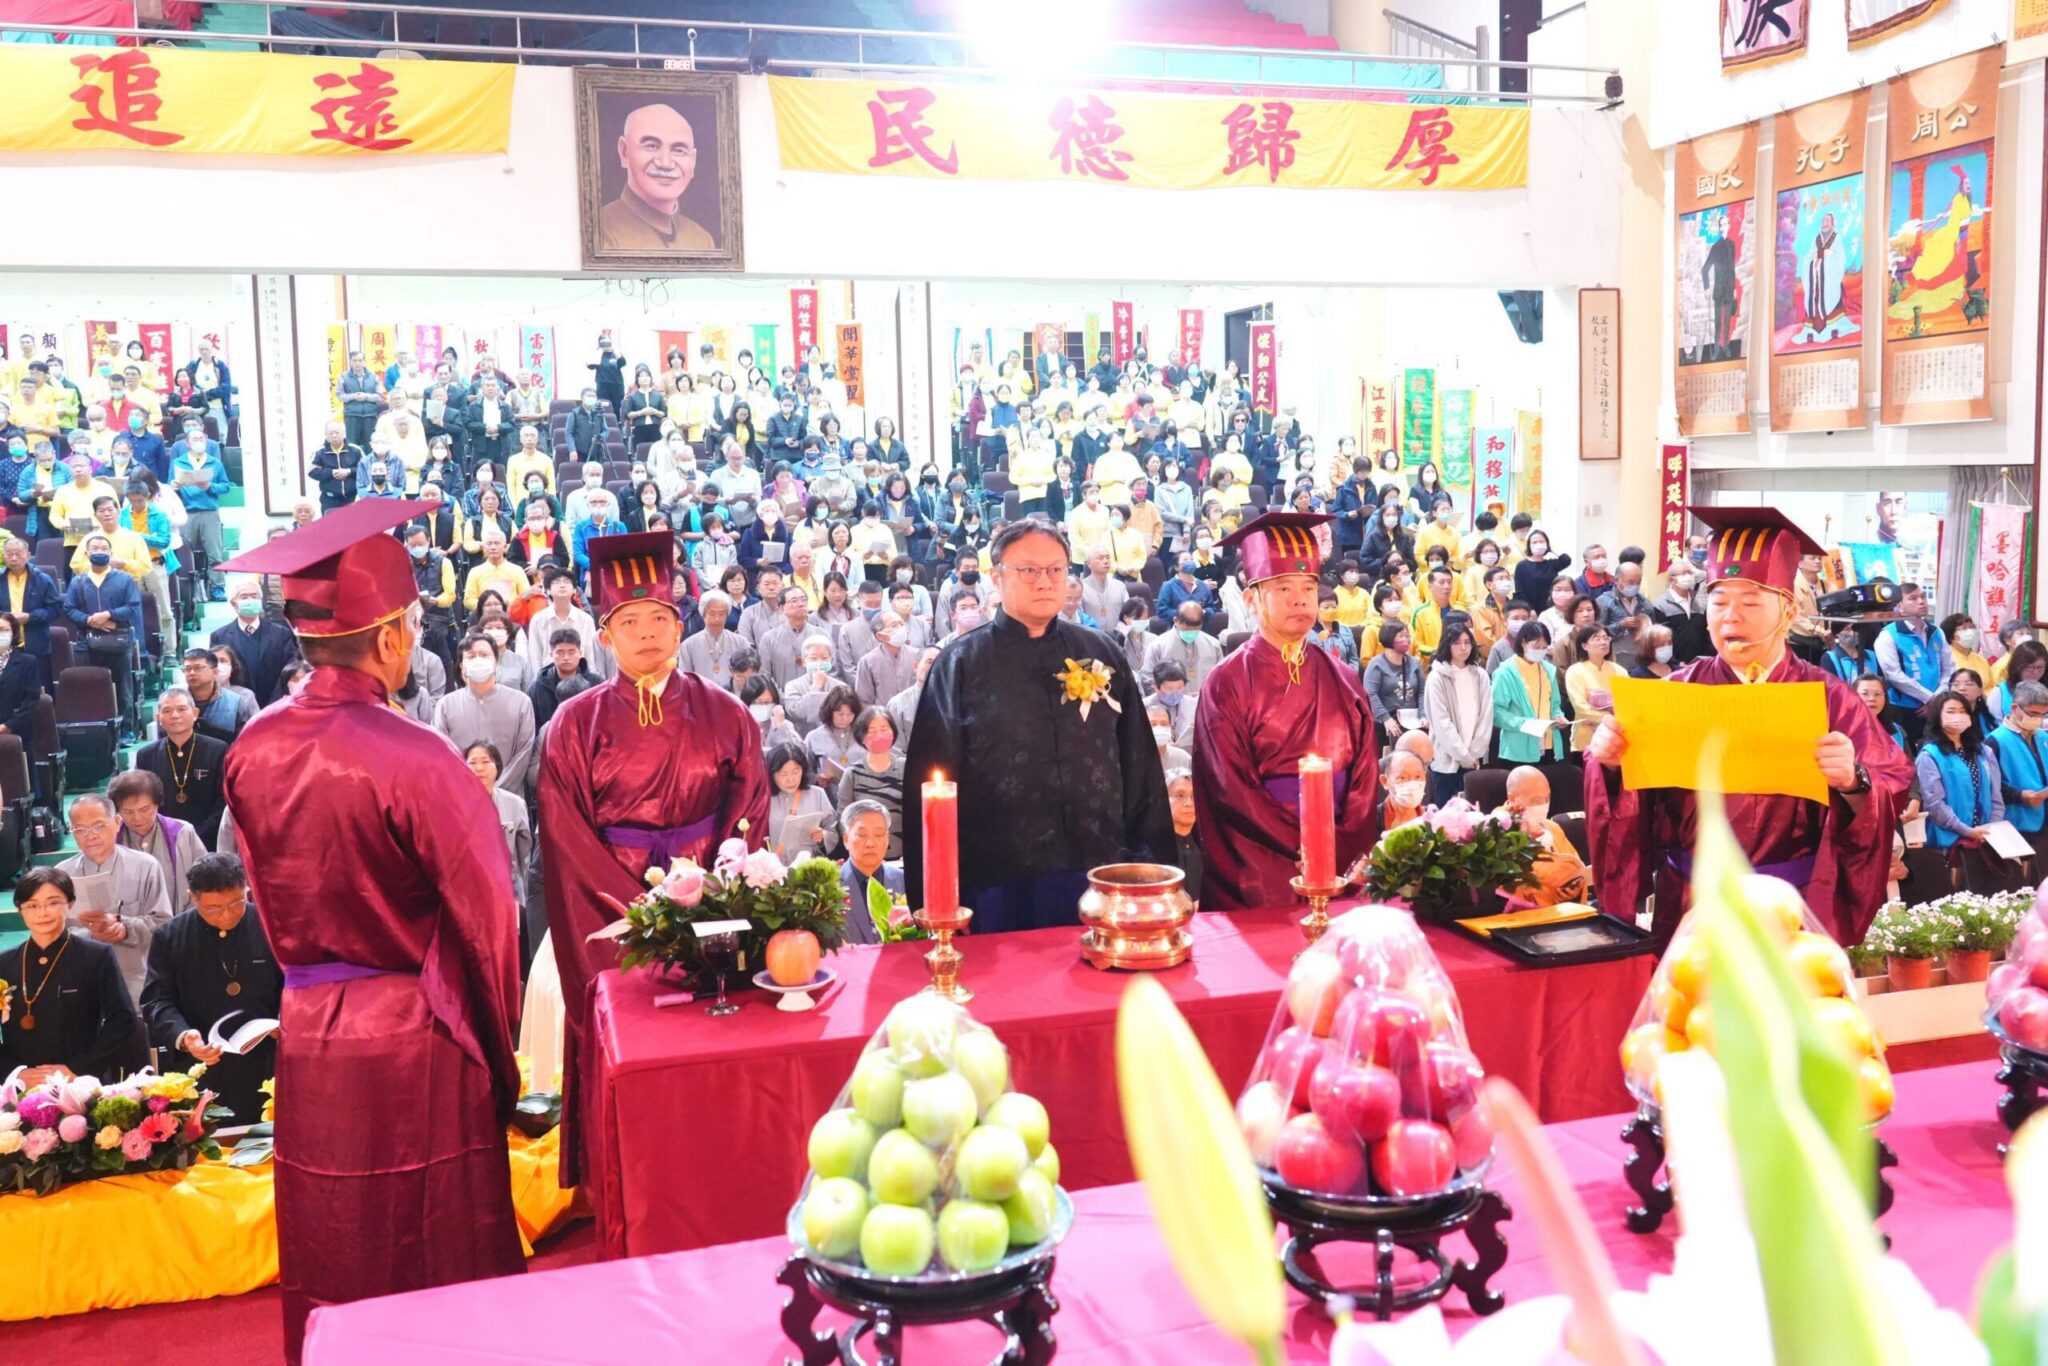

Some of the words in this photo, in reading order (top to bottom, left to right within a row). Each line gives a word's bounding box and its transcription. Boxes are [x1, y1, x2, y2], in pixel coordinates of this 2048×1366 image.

[70, 48, 412, 150] 追遠
[867, 88, 1461, 185] 民德歸厚
[1911, 102, 1979, 142] 周公
[1795, 135, 1850, 173] 孔子
[1696, 162, 1744, 198] 國父
